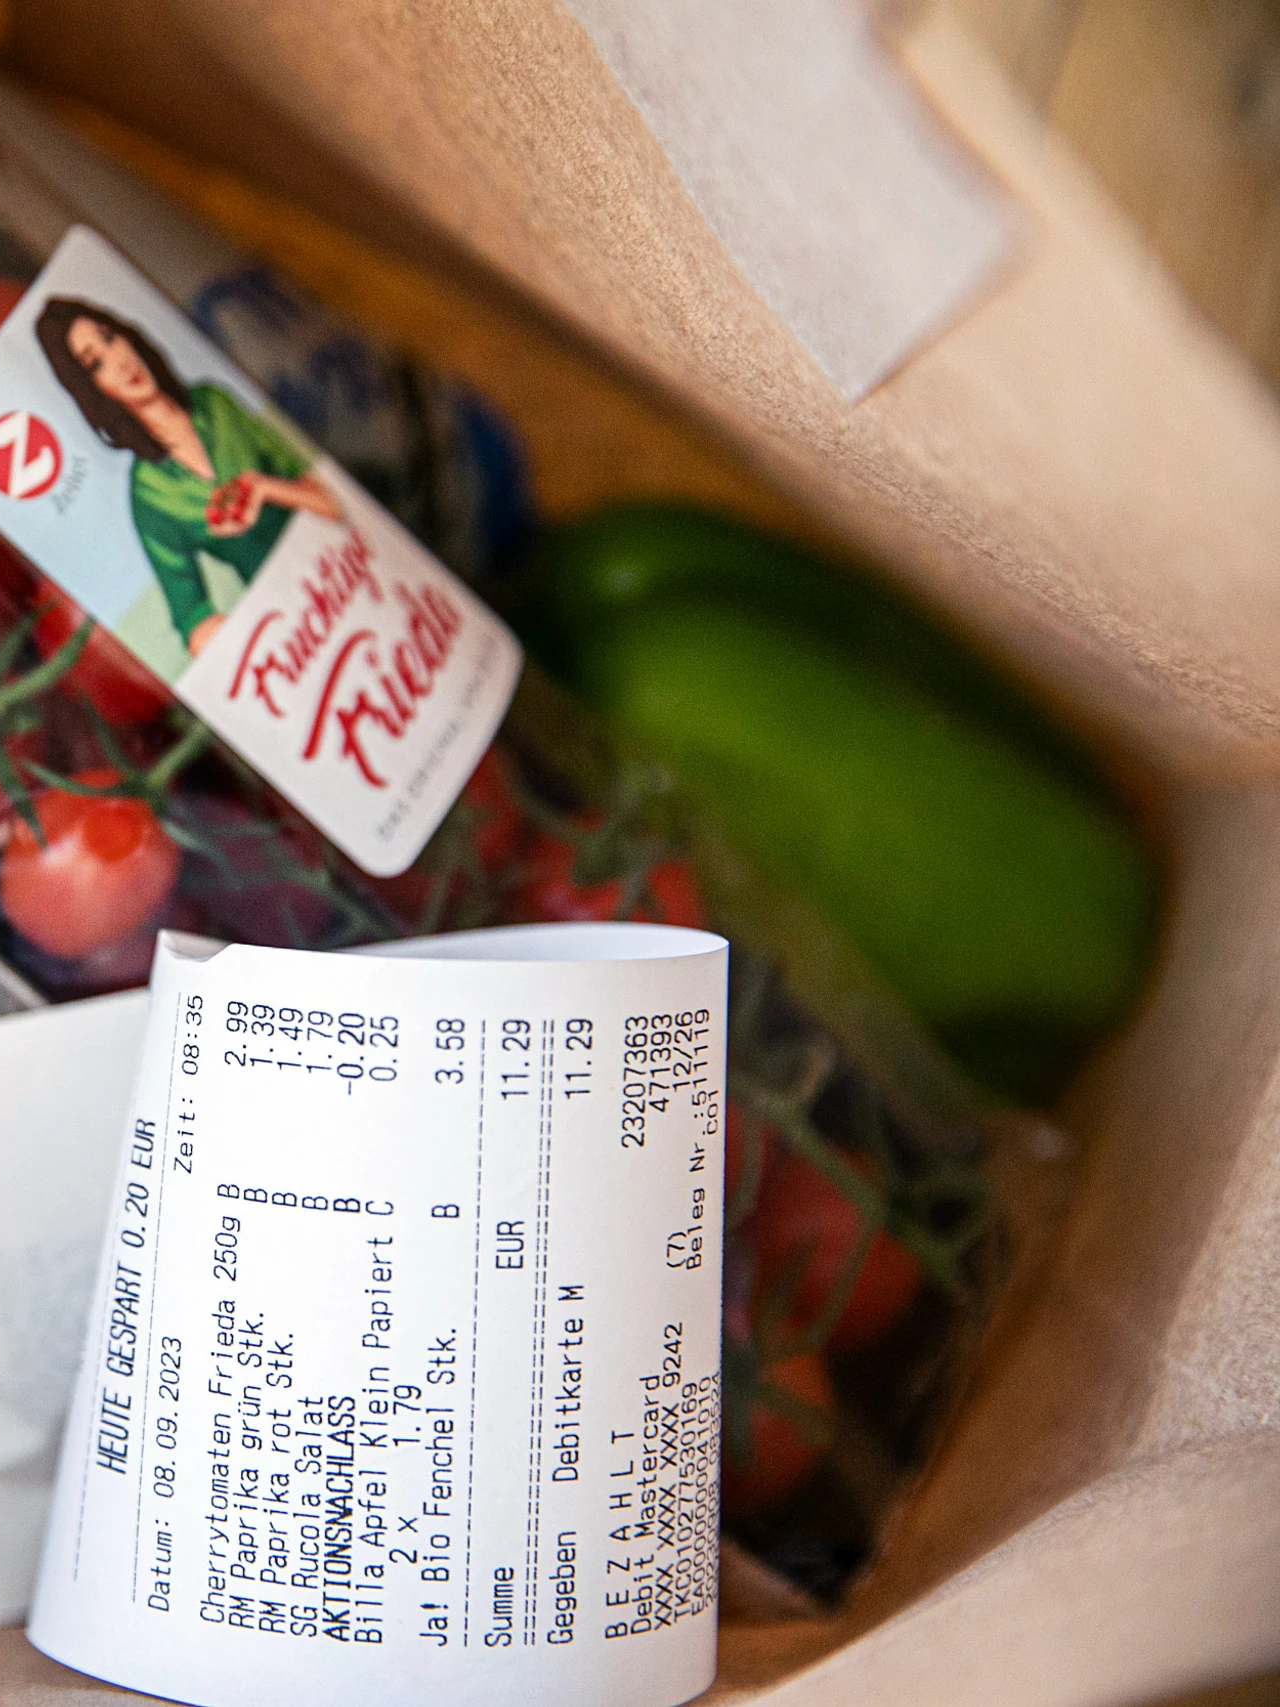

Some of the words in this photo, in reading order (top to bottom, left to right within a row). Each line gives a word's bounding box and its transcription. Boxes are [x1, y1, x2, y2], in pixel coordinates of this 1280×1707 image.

[302, 580, 461, 790] Frieda
[182, 996, 203, 1075] 08:35
[224, 1001, 248, 1067] 2.99
[249, 1004, 275, 1067] 1.39
[277, 1008, 304, 1070] 1.49
[306, 1011, 334, 1073] 1.79
[337, 1013, 365, 1095] -0.20
[369, 1016, 399, 1081] 0.25
[435, 1019, 465, 1084] 3.58
[501, 1019, 531, 1100] 11.29
[564, 1019, 593, 1099] 11.29
[649, 1014, 672, 1112] 471393
[672, 1012, 693, 1092] 12/26
[621, 1016, 648, 1148] 23207363
[131, 1119, 156, 1170] EUR
[174, 1098, 195, 1174] Zeit:
[121, 1183, 149, 1248] 0.20
[217, 1184, 240, 1199] B
[243, 1188, 268, 1203] B
[272, 1192, 297, 1207] B
[302, 1196, 329, 1211] B
[333, 1198, 361, 1213] B
[365, 1201, 394, 1215] C
[431, 1204, 460, 1218] B
[213, 1216, 240, 1282] 250g
[495, 1221, 525, 1269] EUR
[686, 1188, 705, 1270] Beleg
[106, 1261, 142, 1377] GESPART
[362, 1237, 393, 1349] Papiert
[558, 1285, 584, 1301] M
[208, 1300, 235, 1396] Frieda
[237, 1313, 264, 1368] Stk.
[266, 1334, 293, 1388] Stk.
[426, 1329, 456, 1384] Stk.
[662, 1322, 682, 1387] 9242
[96, 1388, 132, 1475] HEUTE
[153, 1336, 181, 1498] 08.09.2023
[238, 1386, 262, 1450] grün
[266, 1409, 291, 1453] rot
[359, 1367, 390, 1448] Klein
[392, 1385, 422, 1447] 1.79
[552, 1319, 583, 1482] Debitkarte
[294, 1397, 323, 1474] Salat
[423, 1408, 454, 1516] Fenchel
[634, 1375, 660, 1538] Mastercard
[659, 1403, 679, 1470] XXXX
[200, 1413, 231, 1623] Cherrytomaten
[230, 1469, 259, 1580] Paprika
[260, 1473, 290, 1585] Paprika
[291, 1494, 321, 1589] Rucola
[322, 1395, 355, 1642] AKTIONSNACHLASS
[358, 1470, 388, 1547] Apfel
[398, 1517, 418, 1533] x
[657, 1484, 676, 1548] XXXX
[148, 1519, 172, 1612] Datum:
[389, 1549, 417, 1564] 2
[421, 1534, 450, 1582] Bio
[547, 1531, 577, 1644] Gegeben
[229, 1595, 255, 1629] RM
[259, 1600, 286, 1634] RM
[290, 1605, 318, 1637] SG
[354, 1565, 384, 1644] Billa
[419, 1603, 449, 1647] Ja!
[484, 1567, 514, 1647] Summe
[630, 1554, 654, 1634] Debit
[655, 1565, 672, 1630] XXXX
